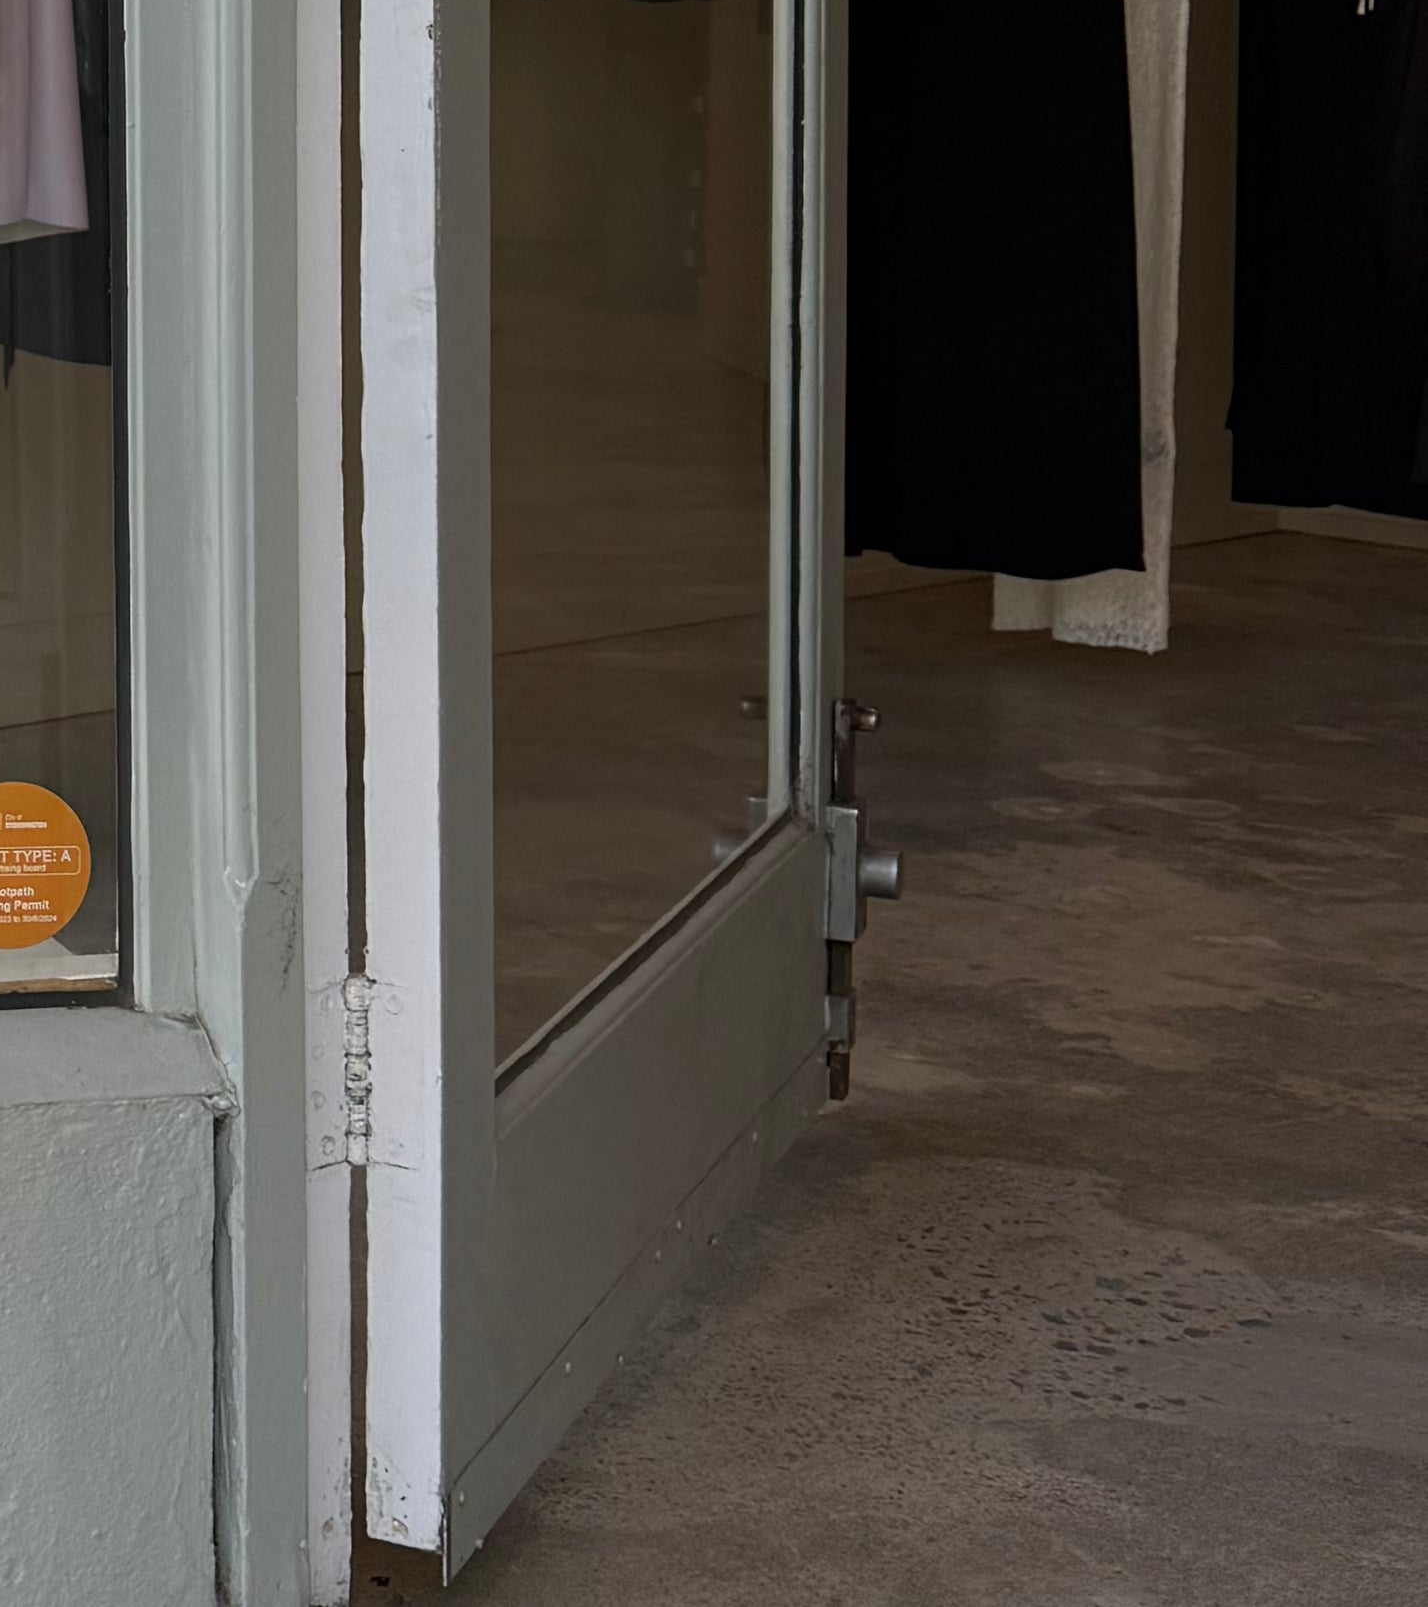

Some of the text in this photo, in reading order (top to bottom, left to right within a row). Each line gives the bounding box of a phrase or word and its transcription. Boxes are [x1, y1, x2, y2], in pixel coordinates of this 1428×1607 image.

[13, 850, 57, 863] TYPE:
[60, 849, 71, 862] A
[13, 900, 50, 911] Permit
